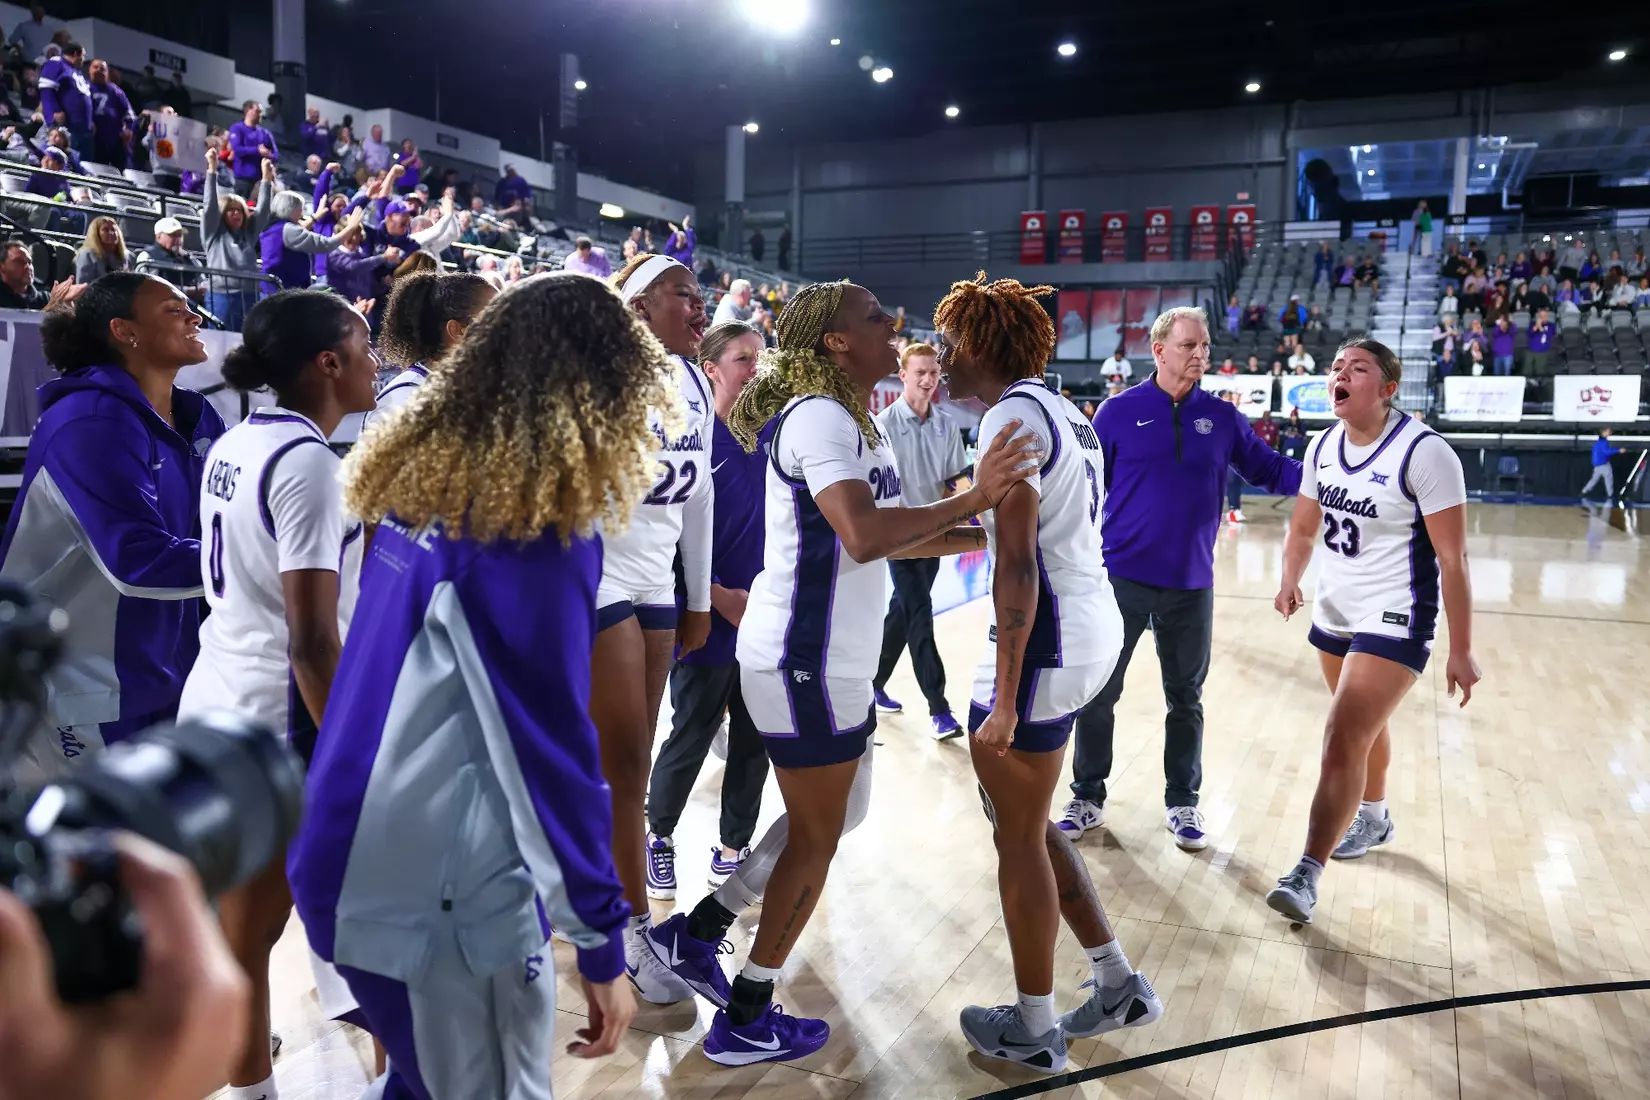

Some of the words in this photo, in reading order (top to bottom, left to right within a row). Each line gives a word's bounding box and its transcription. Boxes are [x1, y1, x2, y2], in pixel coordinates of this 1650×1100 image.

[642, 460, 697, 505] 22
[1085, 457, 1099, 527] 3
[1317, 481, 1379, 518] Wildcats
[210, 511, 225, 599] 0
[1324, 512, 1360, 558] 23
